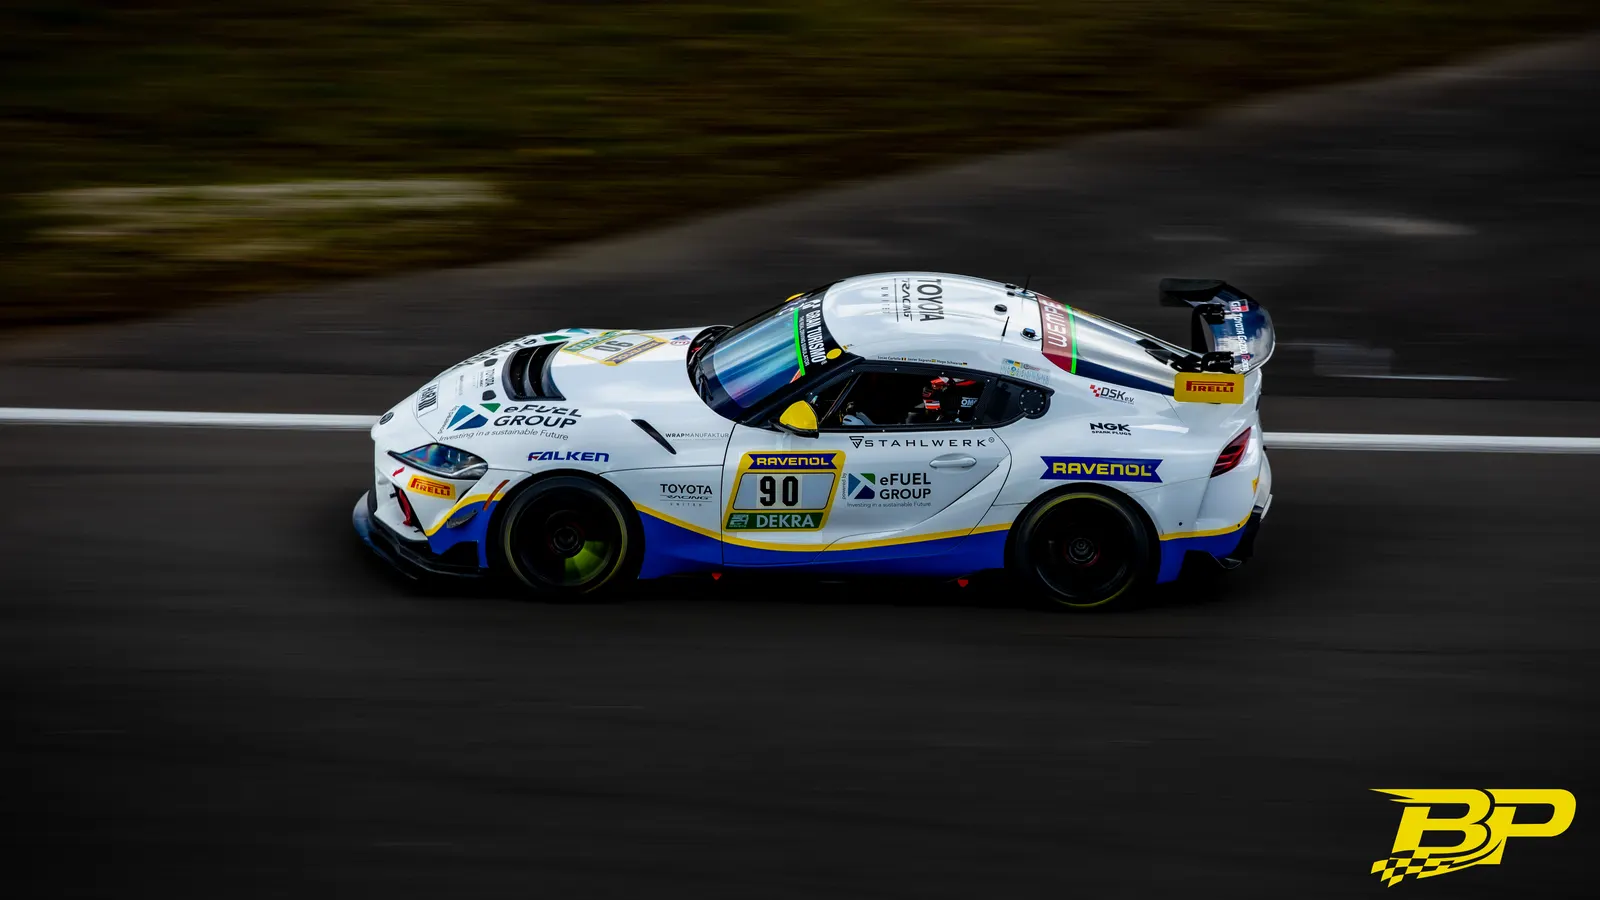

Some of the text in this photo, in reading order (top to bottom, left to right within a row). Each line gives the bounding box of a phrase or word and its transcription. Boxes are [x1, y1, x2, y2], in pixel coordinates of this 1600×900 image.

[917, 278, 944, 322] TOYOTA
[806, 309, 821, 329] GRAN
[807, 326, 827, 363] TURISMO
[1186, 380, 1235, 393] PIRELLI
[1101, 387, 1126, 400] DSK
[503, 404, 582, 418] eFUEL
[493, 415, 577, 428] GROUP
[1090, 422, 1131, 432] NGK
[439, 432, 474, 441] Investing
[491, 428, 539, 436] sustainable
[540, 429, 569, 441] Future
[527, 451, 610, 462] FALKEN
[757, 457, 829, 466] RAVENOL
[1052, 462, 1152, 477] RAVENOL
[880, 472, 932, 486] eFUEL
[411, 477, 451, 496] PIRELLI
[660, 483, 713, 494] TOYOTA
[760, 475, 799, 507] 90
[880, 488, 932, 500] GROUP
[756, 514, 815, 528] DEKRA
